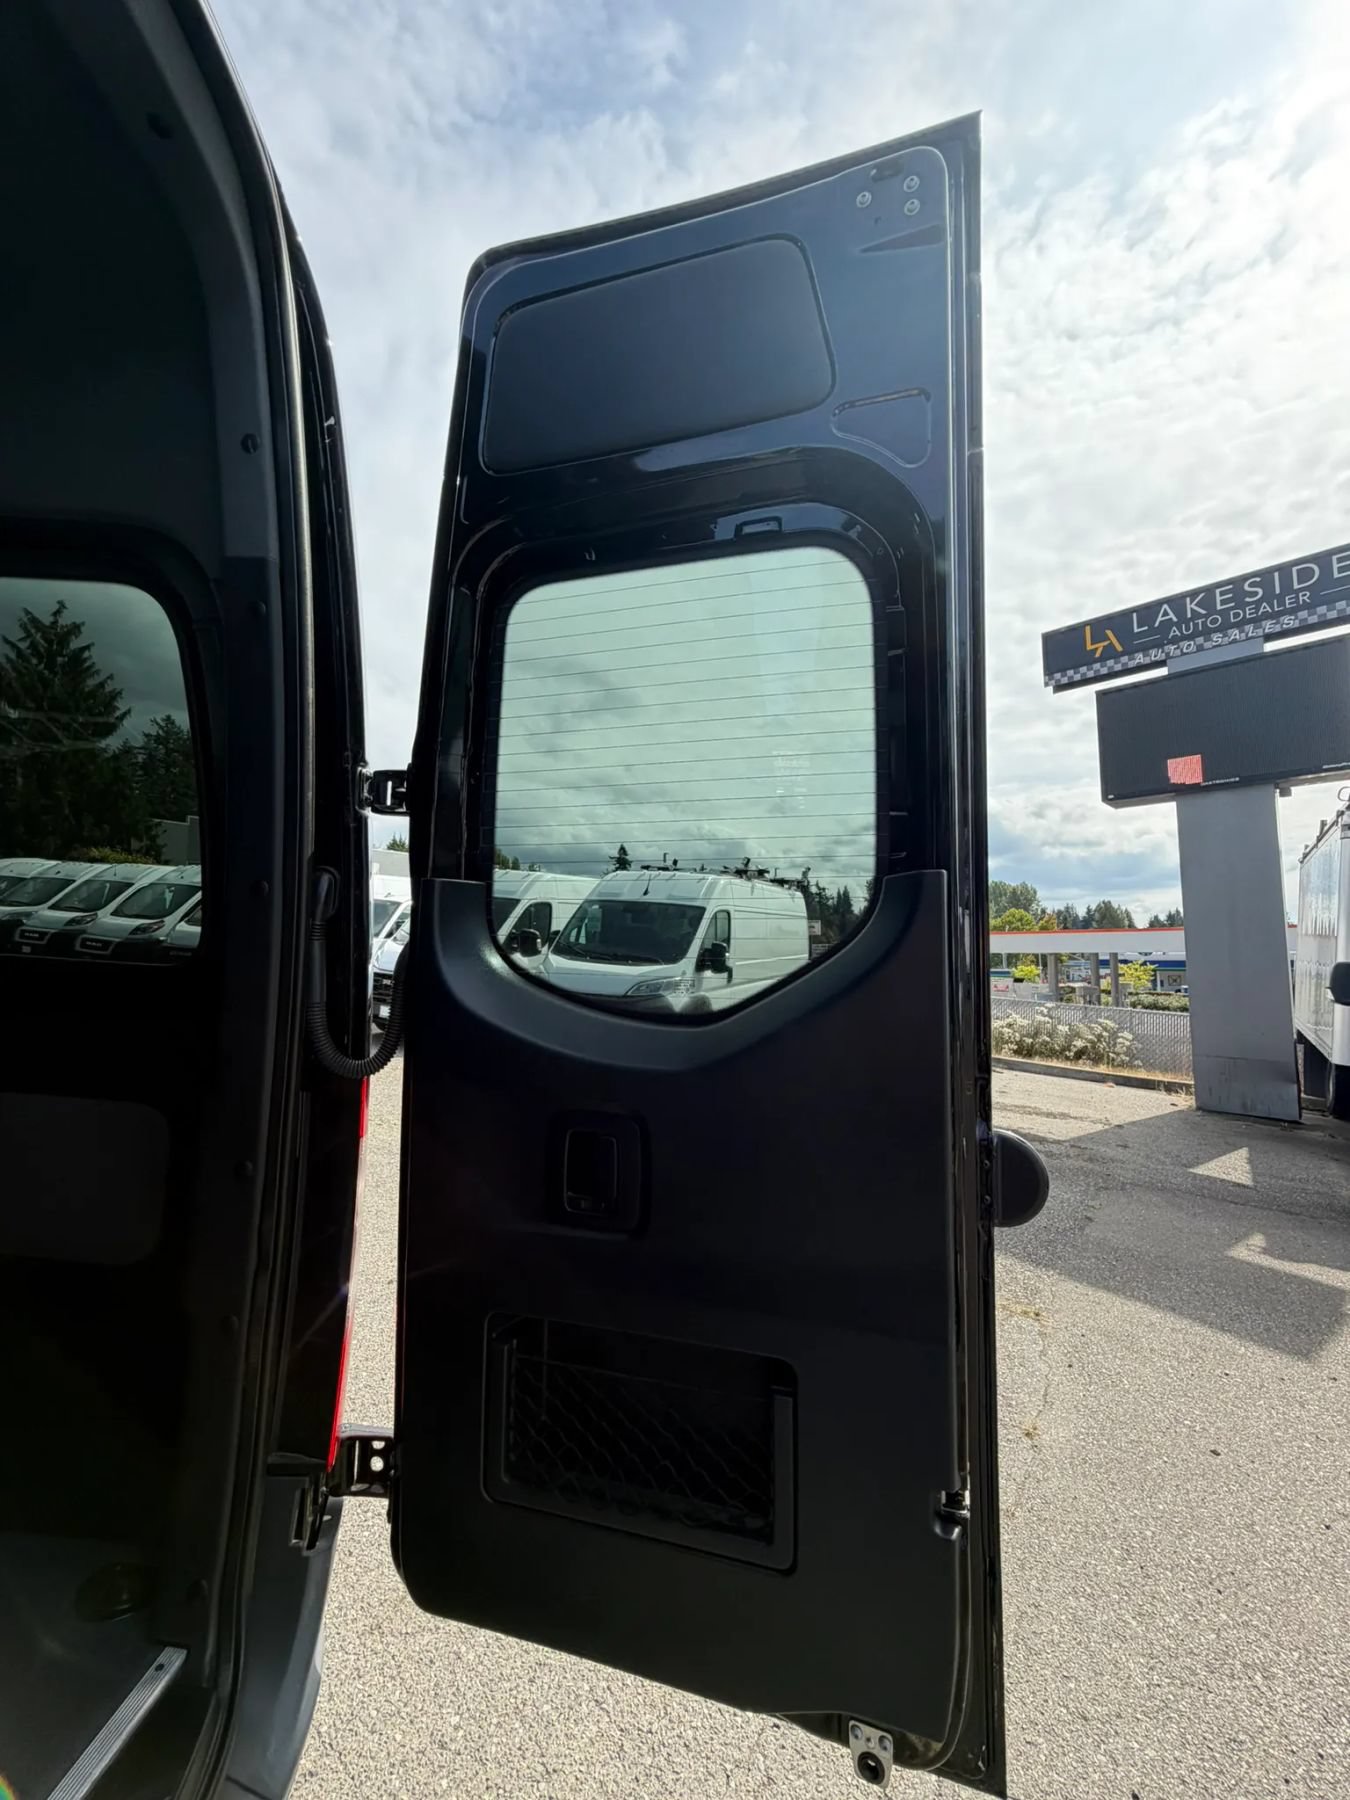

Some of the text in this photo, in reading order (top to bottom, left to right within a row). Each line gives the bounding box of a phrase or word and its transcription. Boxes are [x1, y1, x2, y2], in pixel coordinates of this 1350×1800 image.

[1132, 551, 1350, 633] LAKESIDE
[1168, 591, 1311, 639] AUTO DEALER
[1134, 615, 1297, 665] AUTO SALES
